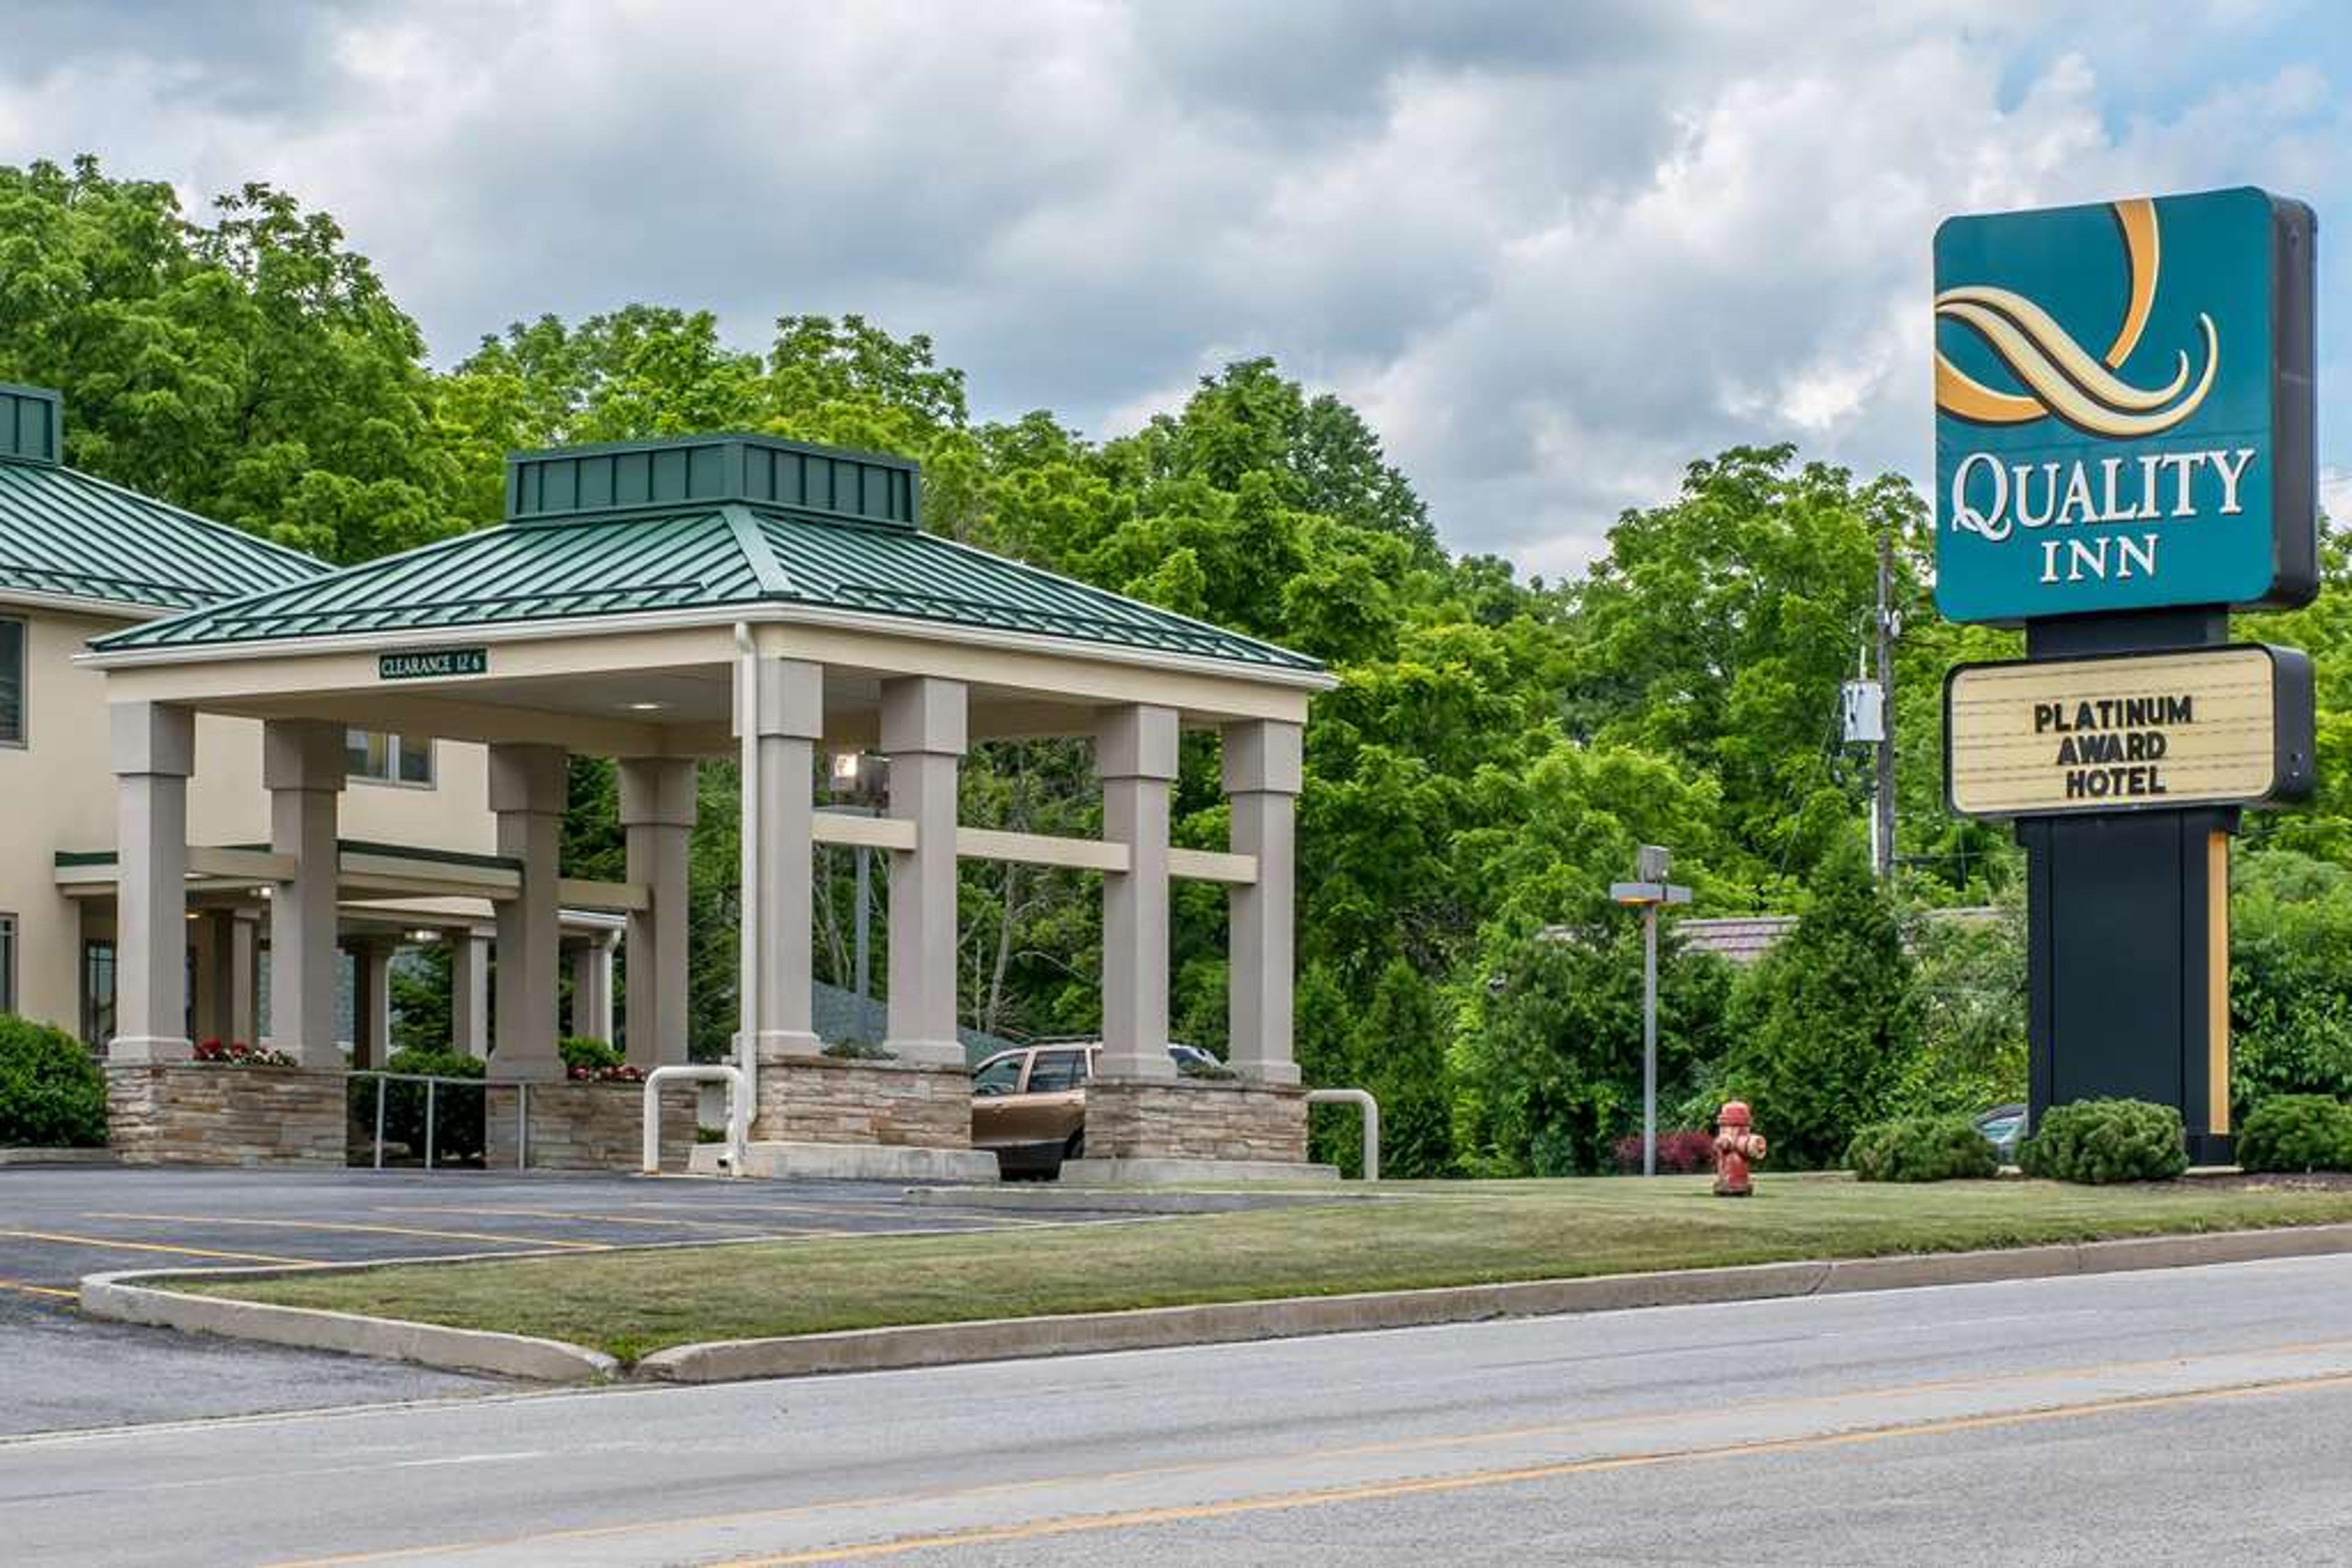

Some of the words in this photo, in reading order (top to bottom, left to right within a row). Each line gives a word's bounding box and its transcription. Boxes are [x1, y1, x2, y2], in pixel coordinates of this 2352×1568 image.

[1951, 448, 2255, 541] QUALITY
[2040, 534, 2159, 582] INN
[382, 654, 452, 676] CLEARANCE
[2034, 696, 2192, 733] PLATINUM
[2057, 731, 2166, 766] AWARD
[2067, 766, 2166, 798] HOTEL
